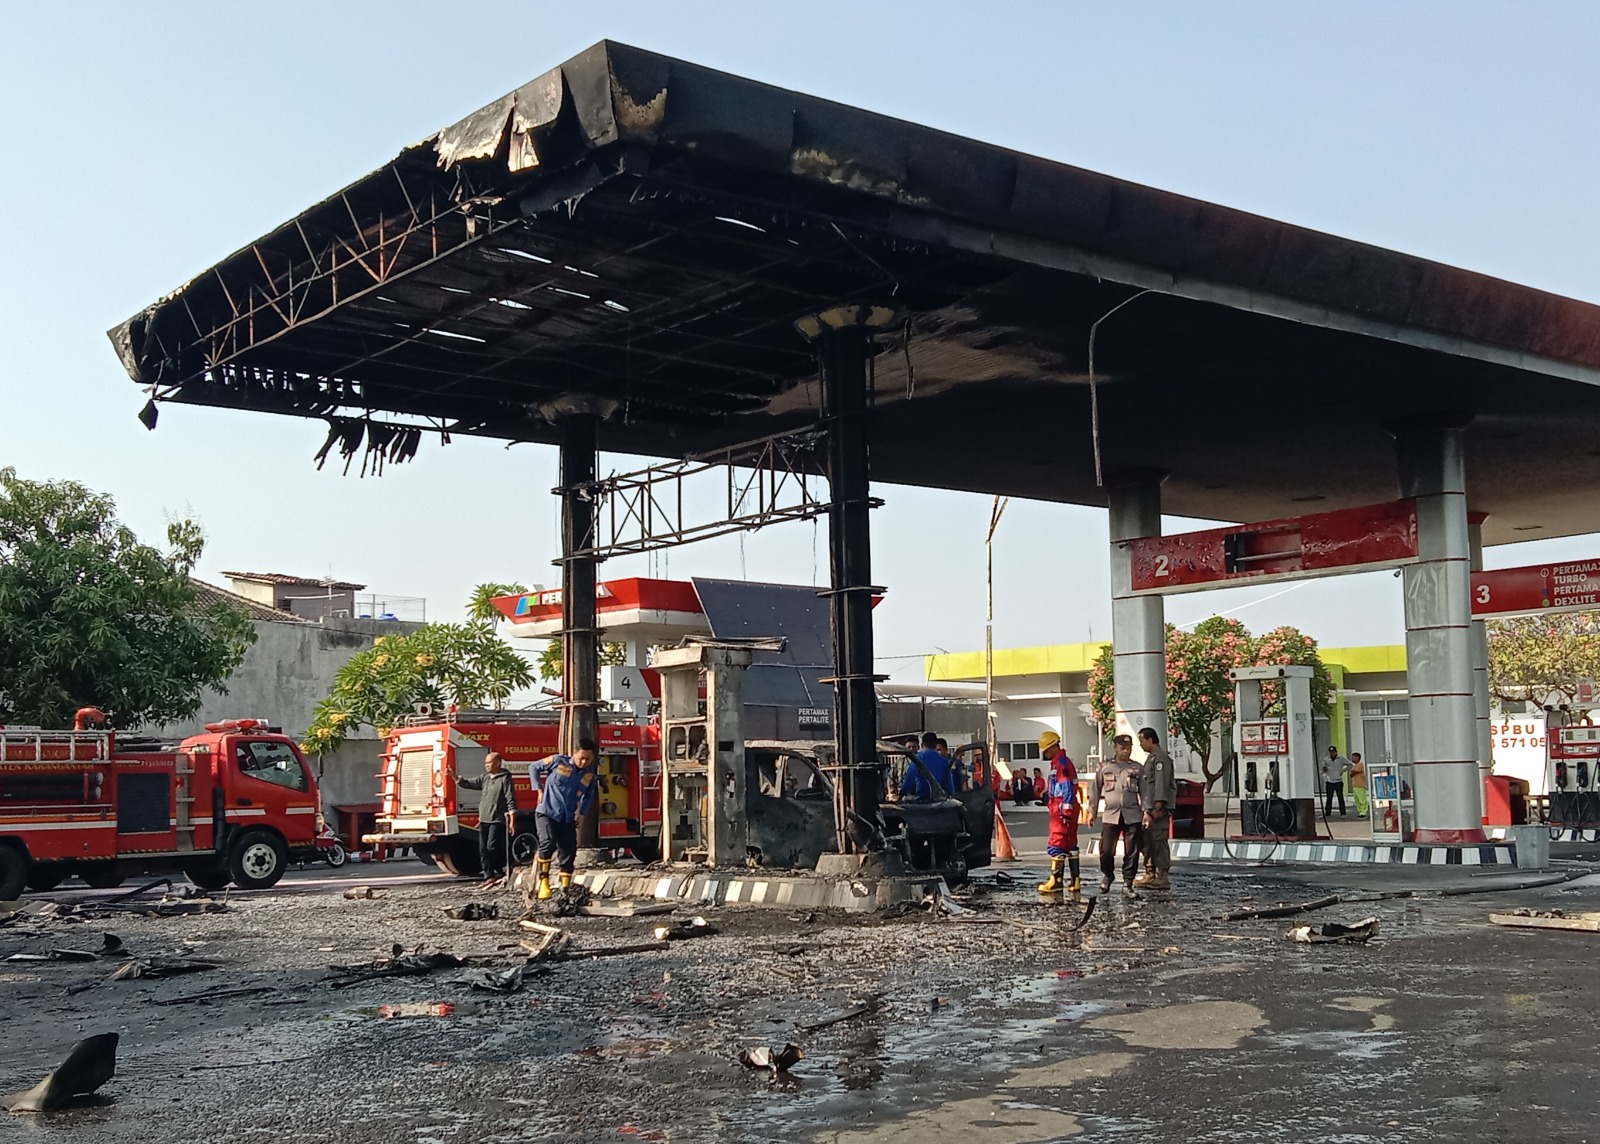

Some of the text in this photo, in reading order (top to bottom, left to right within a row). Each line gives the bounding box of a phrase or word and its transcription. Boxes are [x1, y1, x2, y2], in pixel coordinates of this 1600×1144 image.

[1155, 555, 1169, 577] 2
[1553, 573, 1588, 585] TURBO
[1476, 585, 1490, 604] 3
[1554, 594, 1597, 606] DEXLITE
[621, 676, 631, 689] 4
[798, 708, 829, 716] PERTAMAX
[798, 716, 830, 724] PERTALITE
[1491, 724, 1535, 735] SPBU
